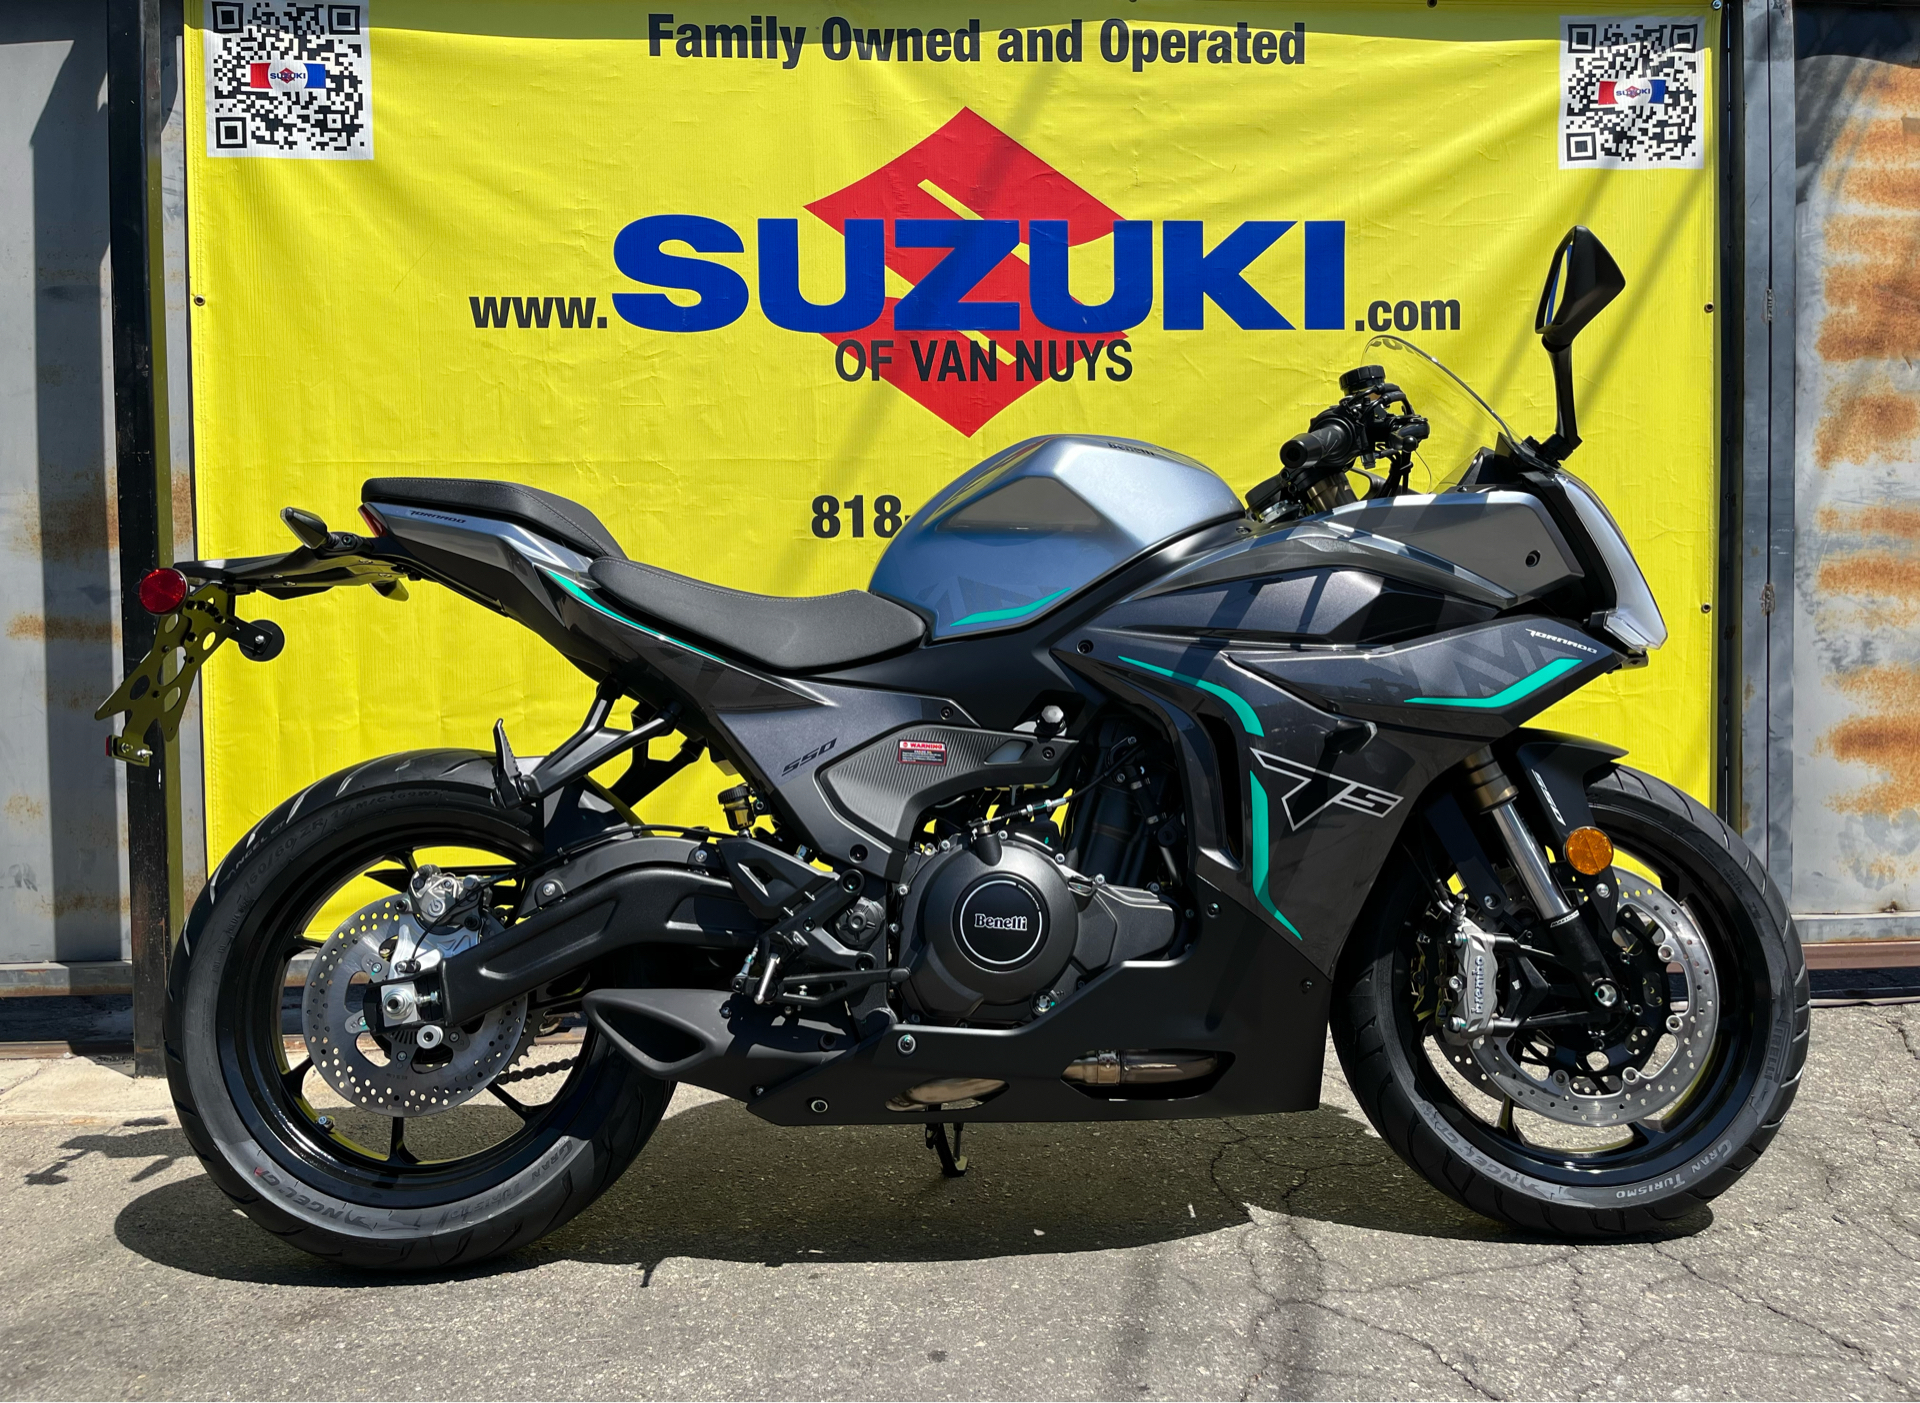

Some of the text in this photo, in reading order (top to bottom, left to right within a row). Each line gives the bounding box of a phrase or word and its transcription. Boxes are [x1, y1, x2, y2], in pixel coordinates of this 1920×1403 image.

[648, 13, 1306, 73] Family Owned and Operated
[1615, 87, 1651, 97] SUZUKI
[834, 339, 1134, 383] OF VAN NUYS
[811, 494, 912, 539] 818
[1525, 628, 1598, 655] TORNADO
[781, 737, 838, 777] 550
[910, 742, 943, 750] WARNING
[974, 912, 1028, 931] Benelli
[1471, 955, 1485, 1015] brembo
[1615, 1139, 1733, 1199] GRAN TURISMO
